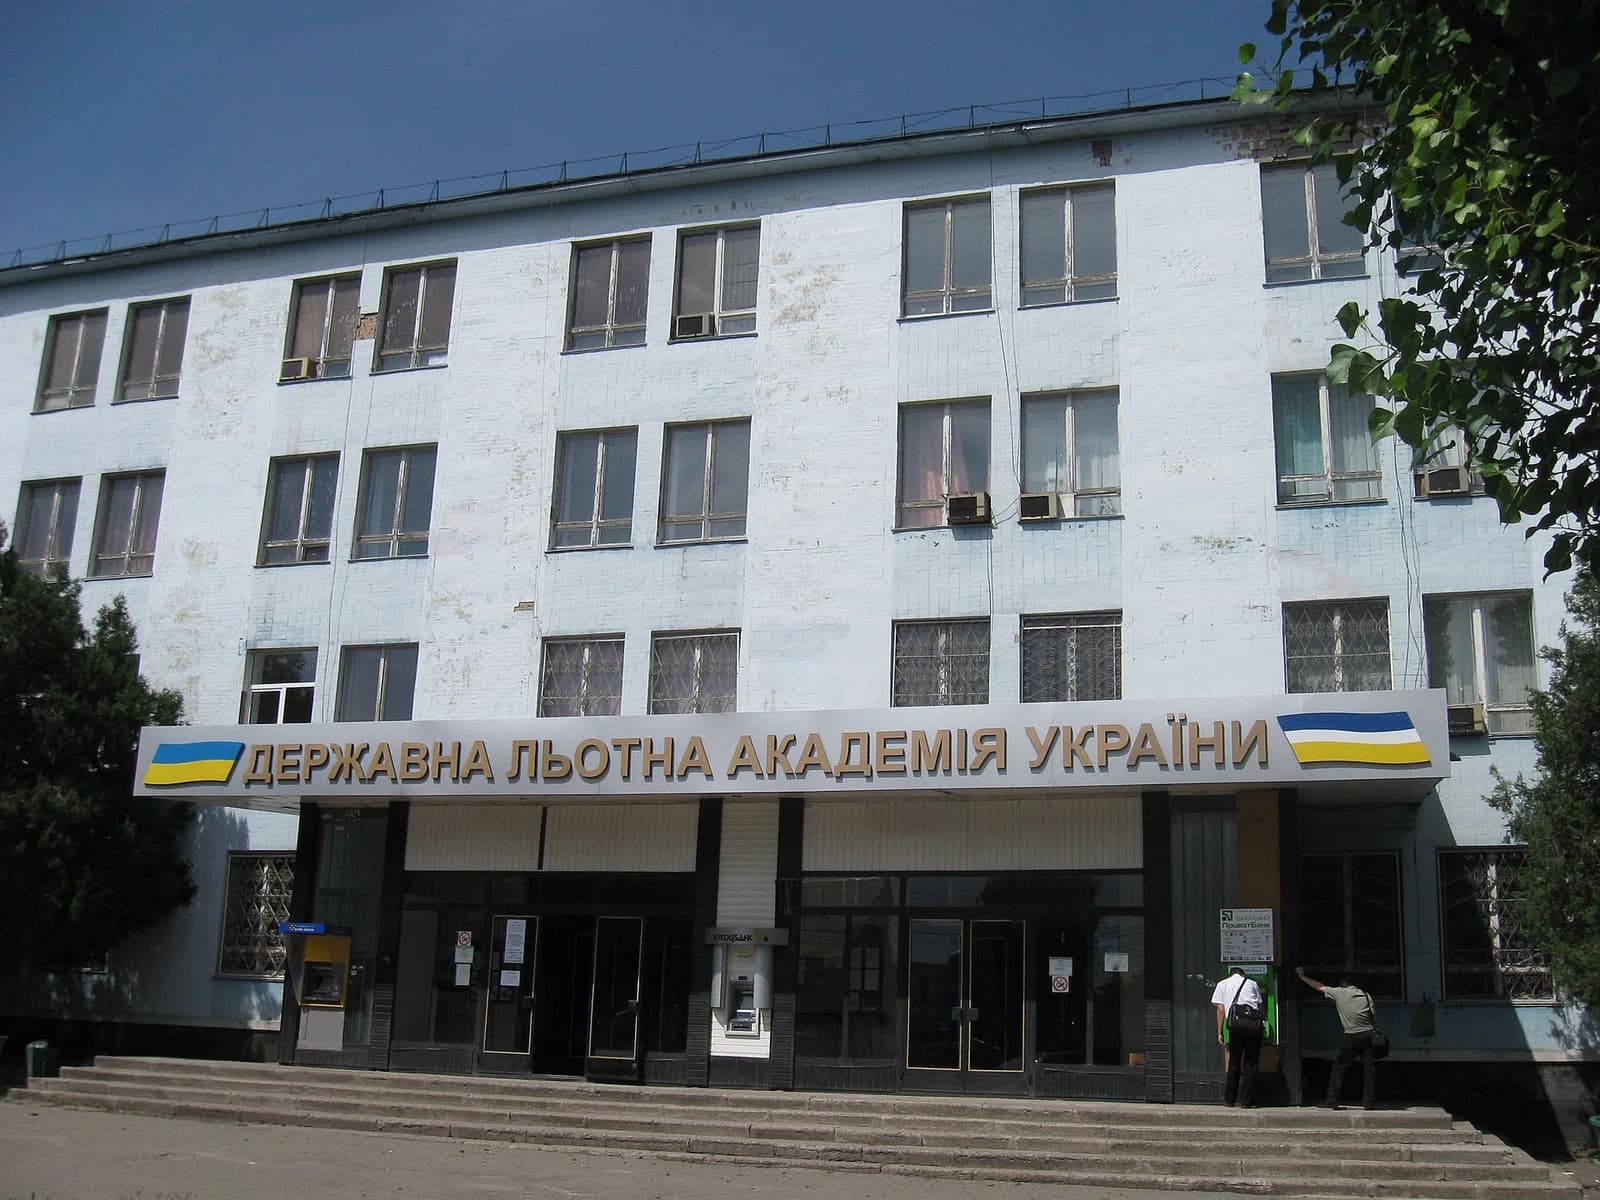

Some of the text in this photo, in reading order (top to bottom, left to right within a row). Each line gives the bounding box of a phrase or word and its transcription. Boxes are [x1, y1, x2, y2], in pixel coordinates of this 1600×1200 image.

[243, 714, 1268, 784] ДЕРЖАВНА ЛЬОТНА АКАДЕМІЯ УКРАЇНИ
